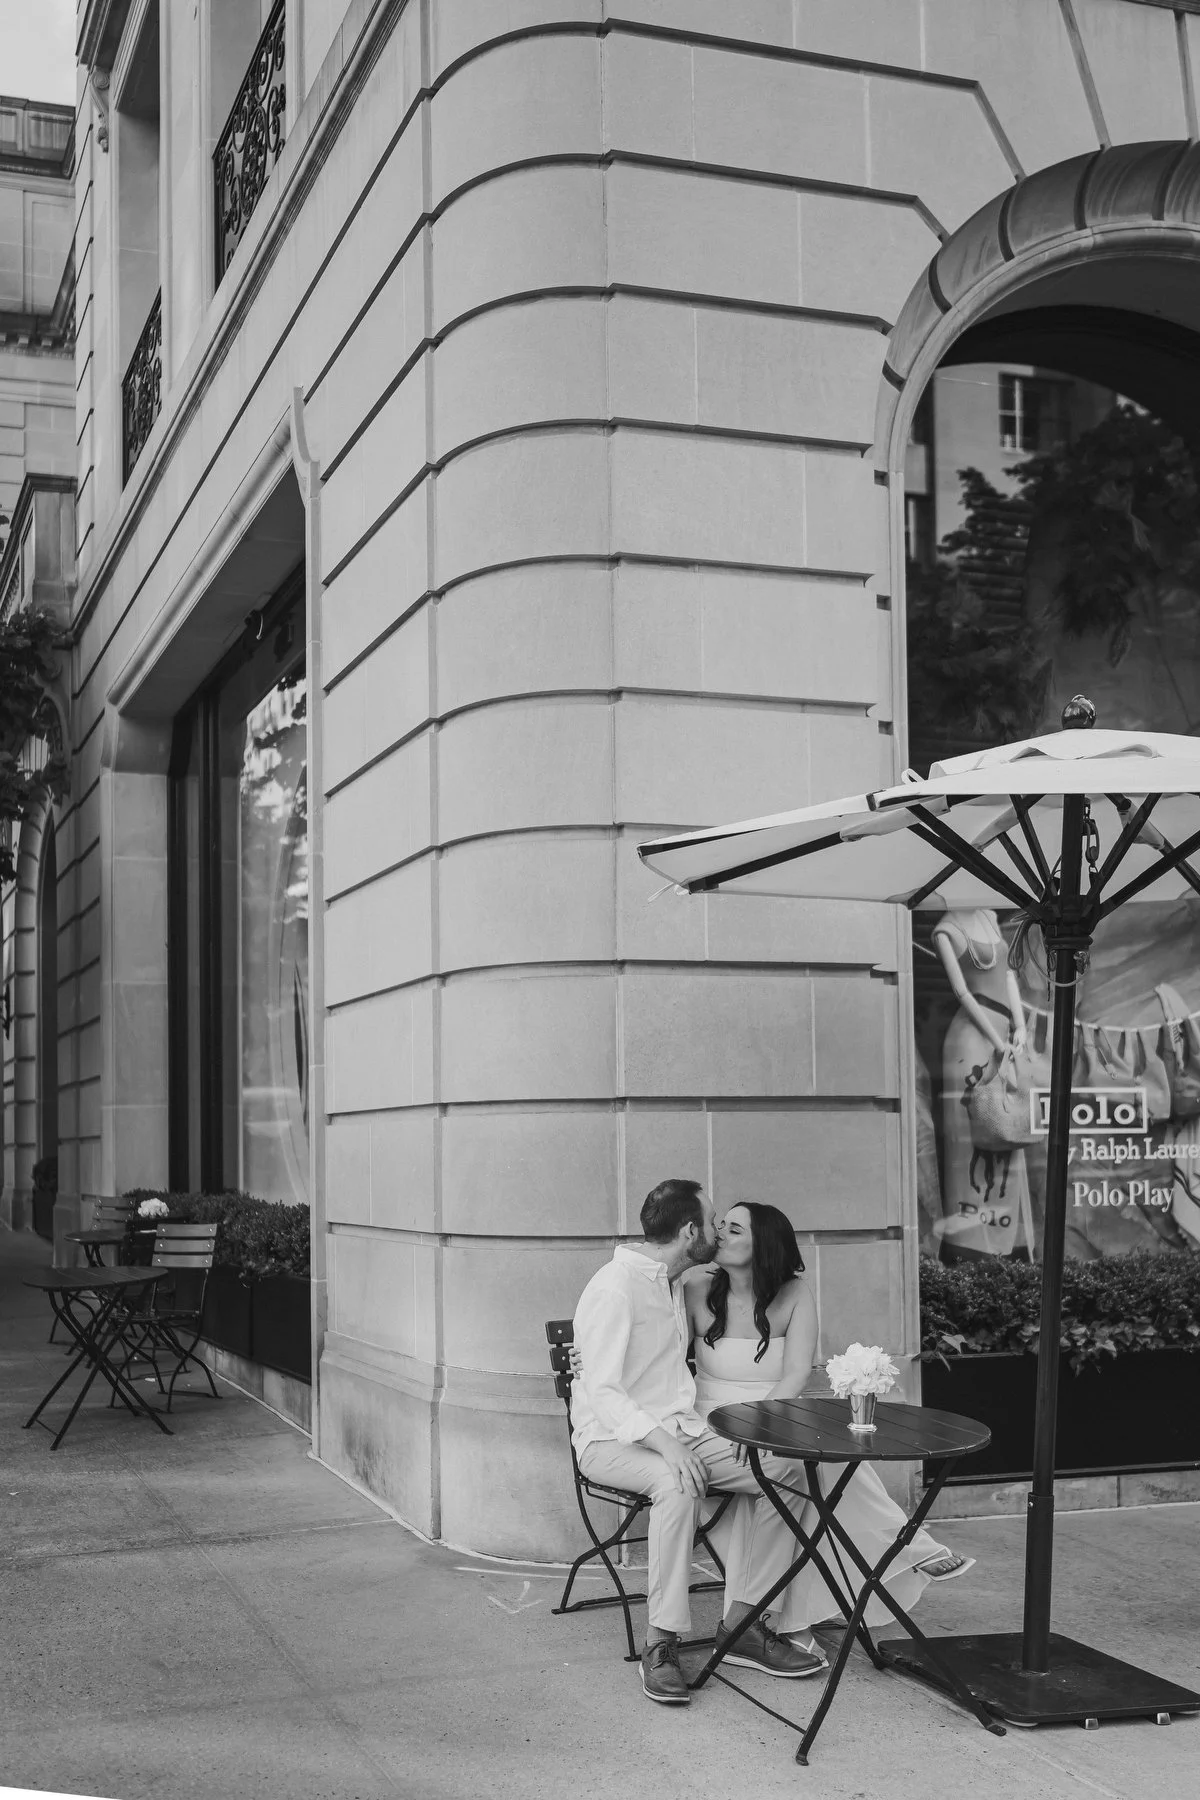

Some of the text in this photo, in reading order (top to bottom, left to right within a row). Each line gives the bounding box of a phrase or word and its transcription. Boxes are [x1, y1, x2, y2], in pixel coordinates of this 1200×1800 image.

[1080, 1137, 1141, 1165] Ralph
[1072, 1180, 1174, 1213] Polo Play
[958, 1201, 1012, 1228] Polo
